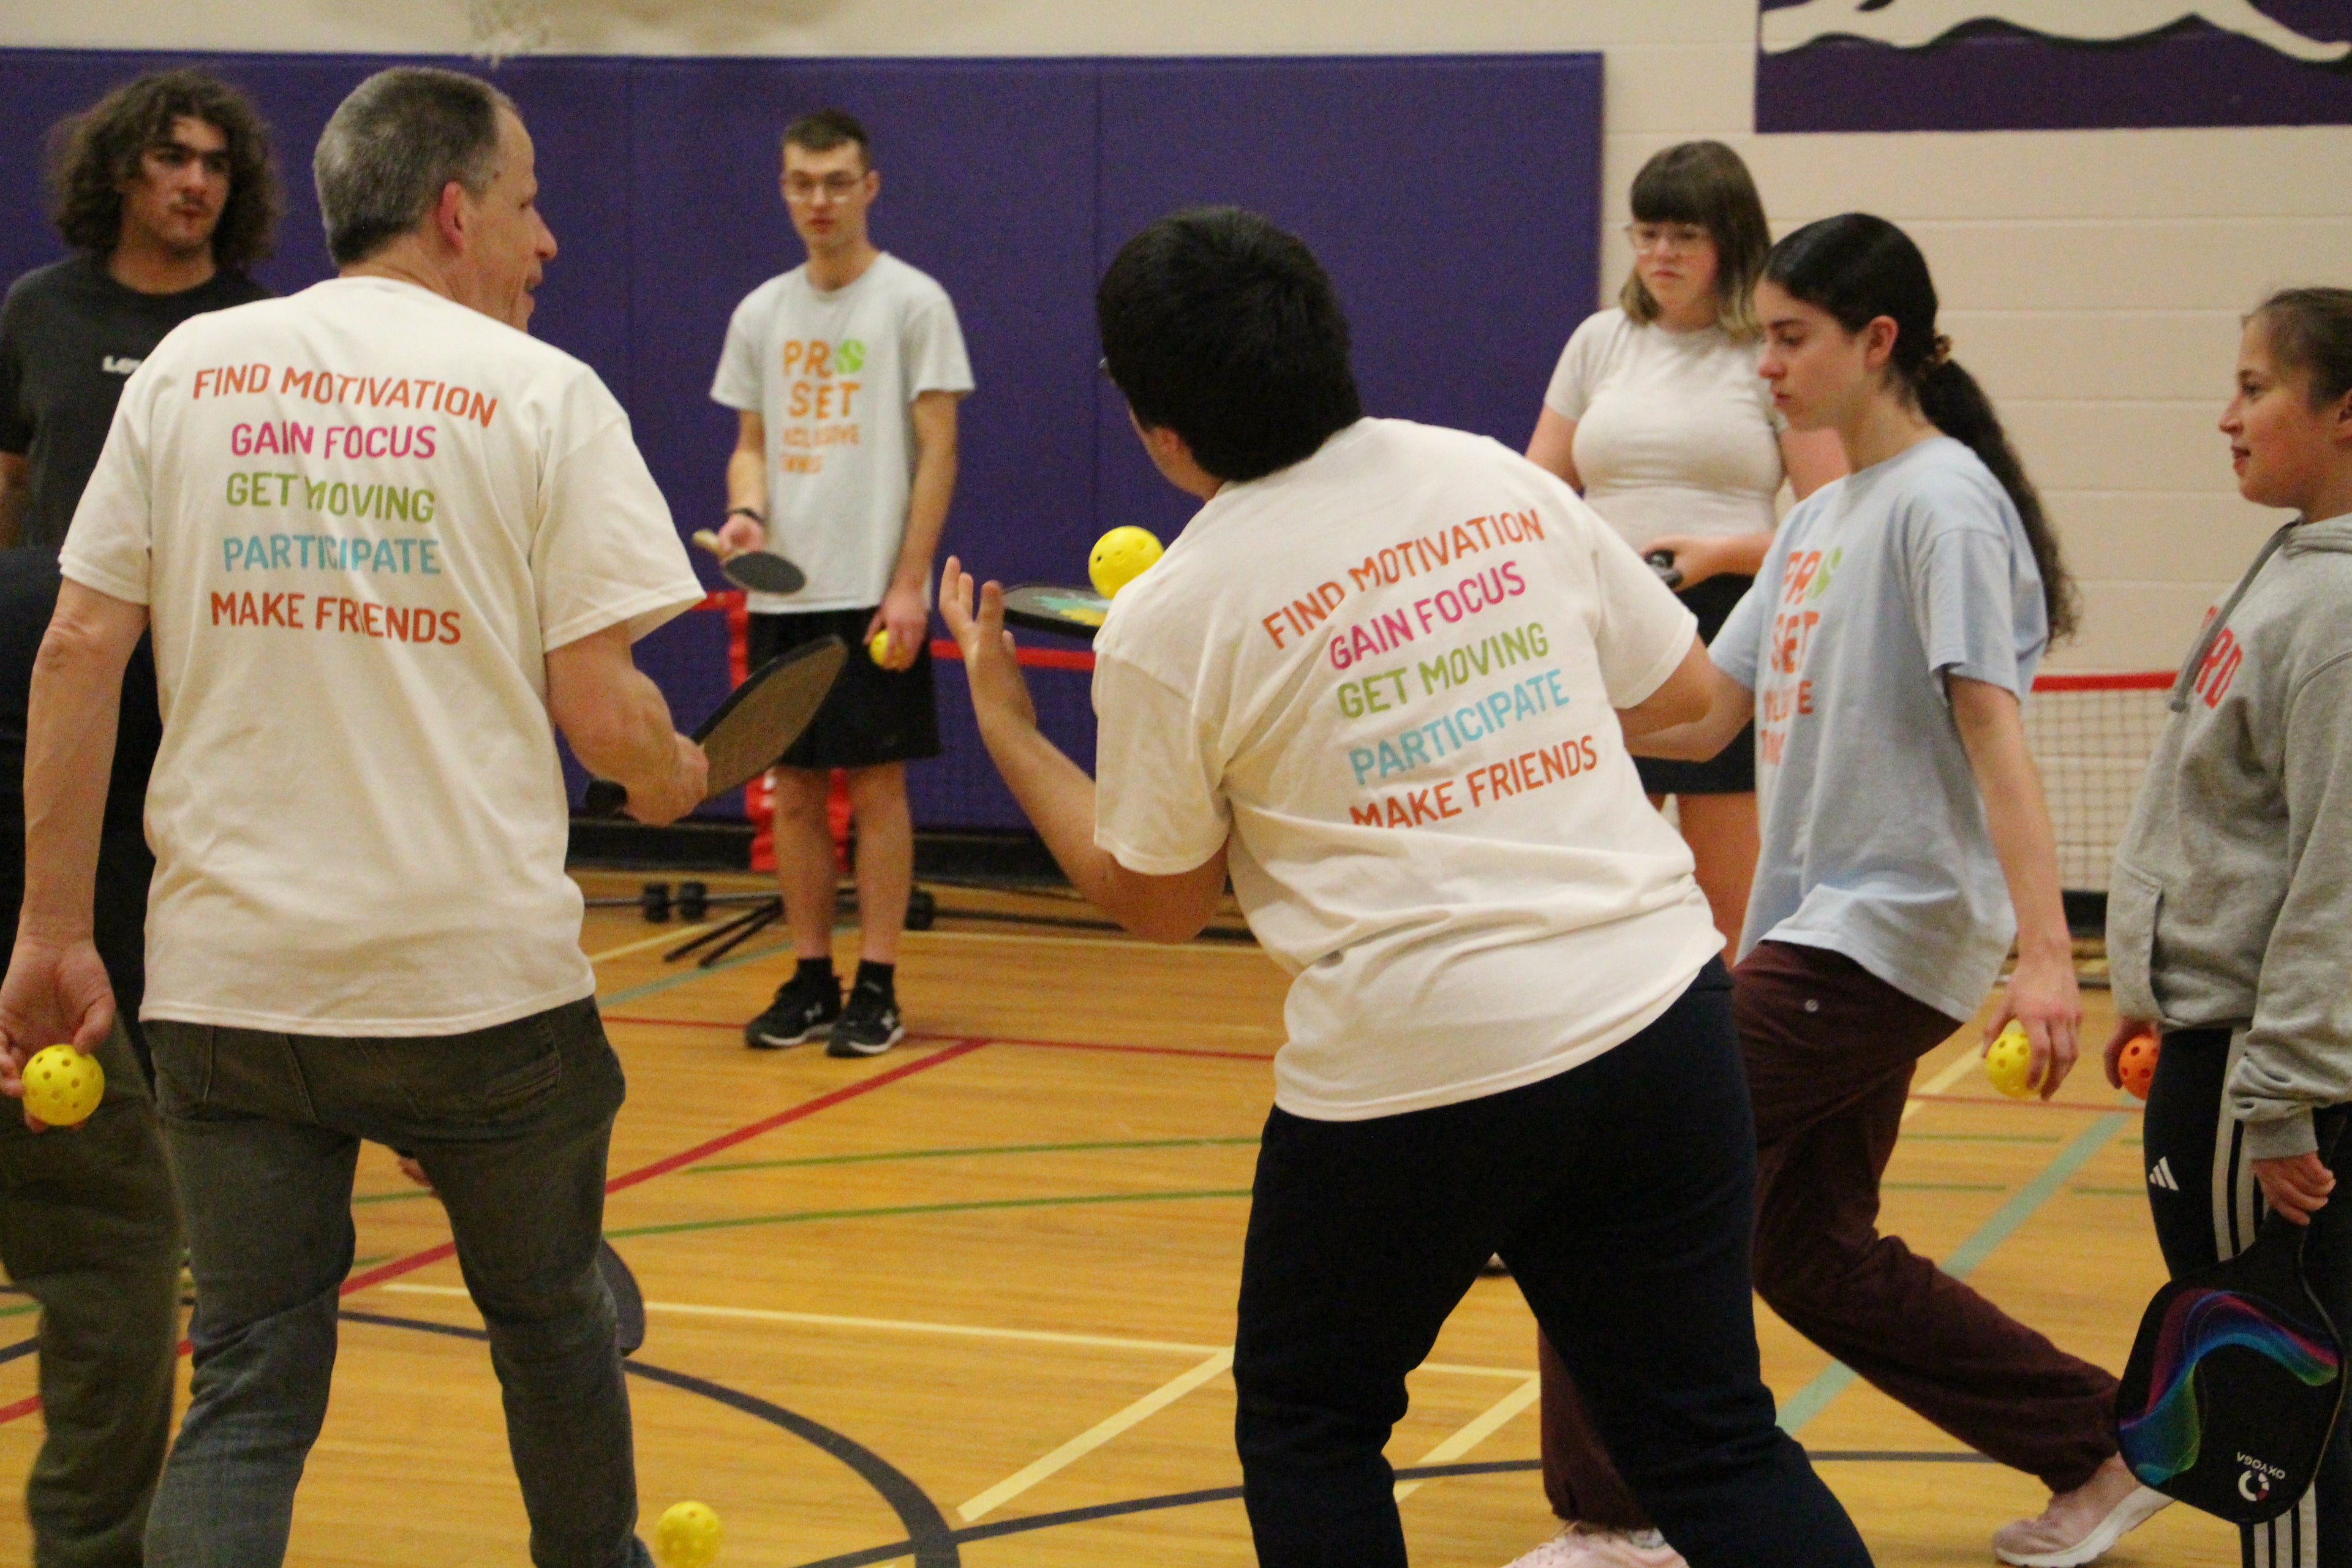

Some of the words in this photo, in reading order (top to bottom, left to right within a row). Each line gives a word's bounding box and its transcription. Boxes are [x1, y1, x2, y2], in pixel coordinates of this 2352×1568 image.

[193, 364, 271, 399] FIND
[281, 366, 497, 429] MOTIVATION
[788, 380, 861, 420] SET
[232, 421, 314, 457] GAIN
[324, 425, 437, 460] FOCUS
[227, 472, 299, 507] GET
[304, 476, 435, 524] MOVING
[210, 591, 306, 630] MAKE
[315, 596, 461, 646] FRENDS
[1261, 581, 1346, 650] FIND
[1348, 508, 1545, 593] MOTIVATION
[1330, 608, 1415, 671] GAIN
[1413, 560, 1526, 635] FOCUS
[1336, 666, 1408, 719] GET
[1417, 622, 1549, 695] MOVING
[1348, 668, 1570, 785] PARTICIPATE
[1349, 780, 1463, 829] MAKE
[1466, 735, 1597, 808] FRIENDS
